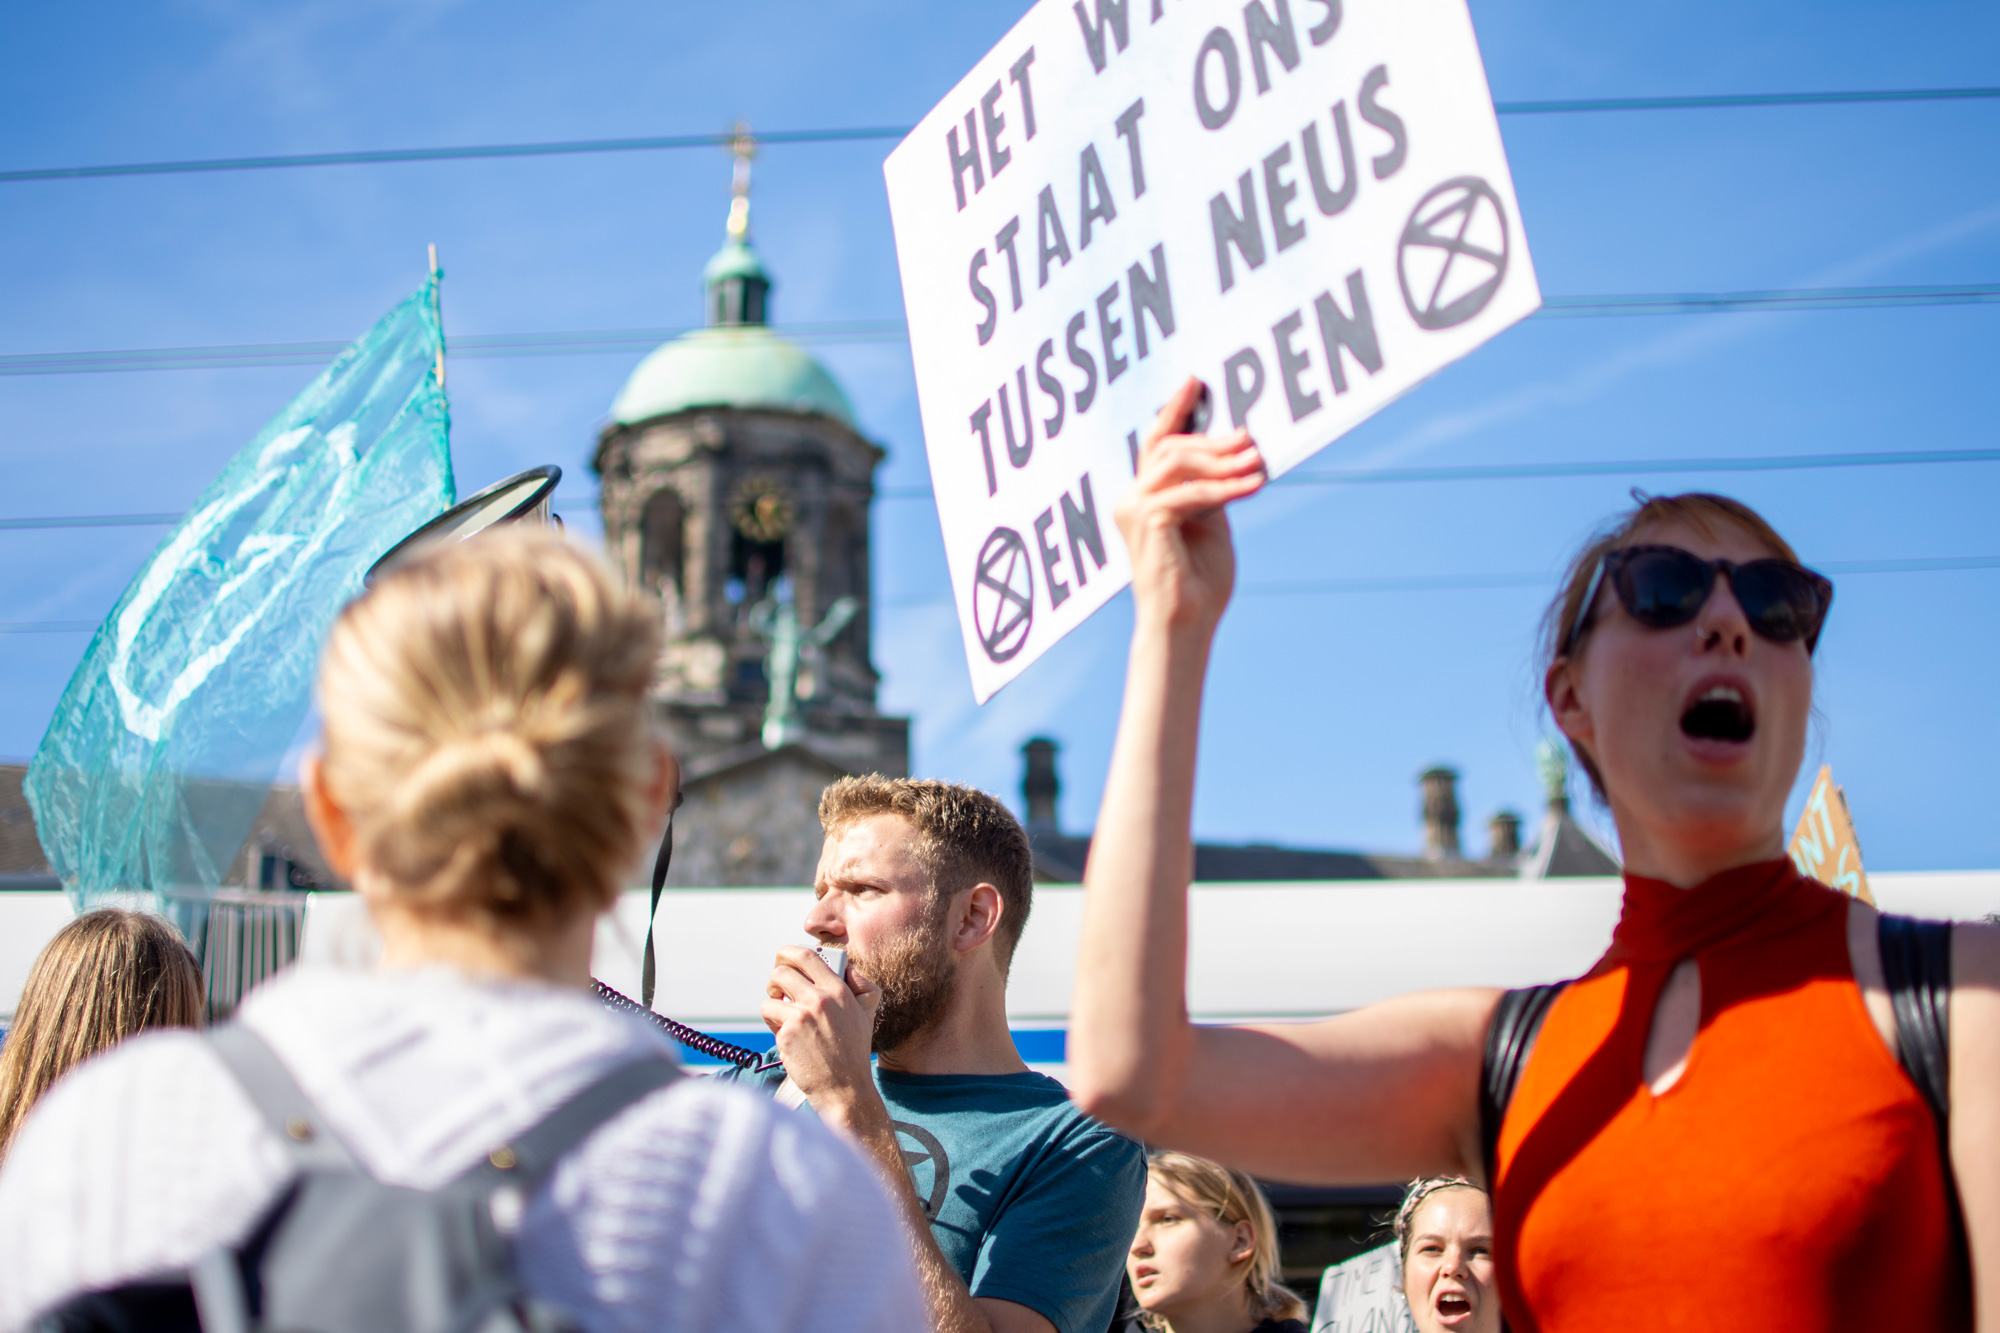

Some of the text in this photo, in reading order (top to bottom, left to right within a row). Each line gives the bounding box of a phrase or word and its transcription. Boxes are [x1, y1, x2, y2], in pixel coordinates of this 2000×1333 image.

[947, 0, 1164, 212] HET W
[969, 97, 1146, 346] STAAT
[970, 64, 1407, 497] TUSSEN NEUS
[1034, 472, 1107, 611] EN
